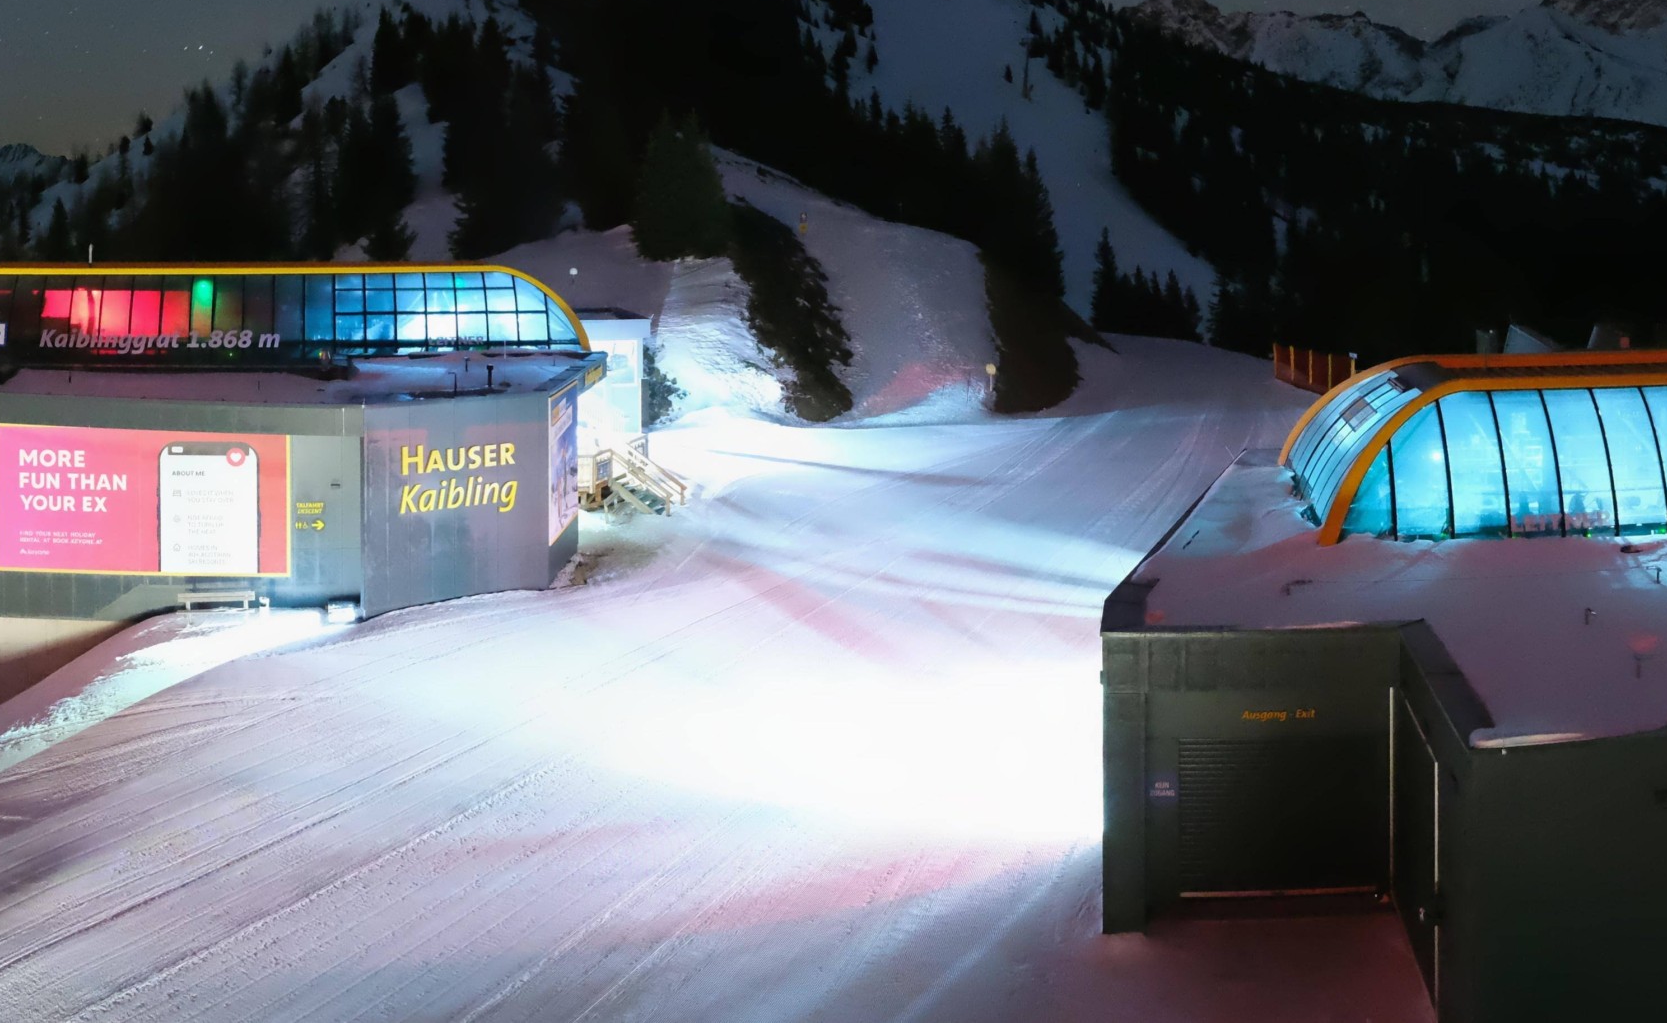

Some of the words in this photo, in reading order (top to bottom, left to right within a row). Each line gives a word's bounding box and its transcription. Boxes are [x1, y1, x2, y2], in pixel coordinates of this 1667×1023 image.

[39, 329, 180, 354] Kaiblinggrat
[186, 329, 252, 348] 1.868
[258, 335, 280, 348] m
[19, 449, 85, 467] MORE
[401, 443, 515, 475] HAUSER
[19, 472, 60, 489] FUN
[67, 473, 127, 491] THAN
[20, 495, 76, 512] YOUR
[82, 496, 107, 512] EX
[400, 476, 518, 514] Kaibling
[1510, 510, 1610, 532] LEITNER
[1241, 710, 1287, 722] Ausgang
[1295, 709, 1315, 719] Exit
